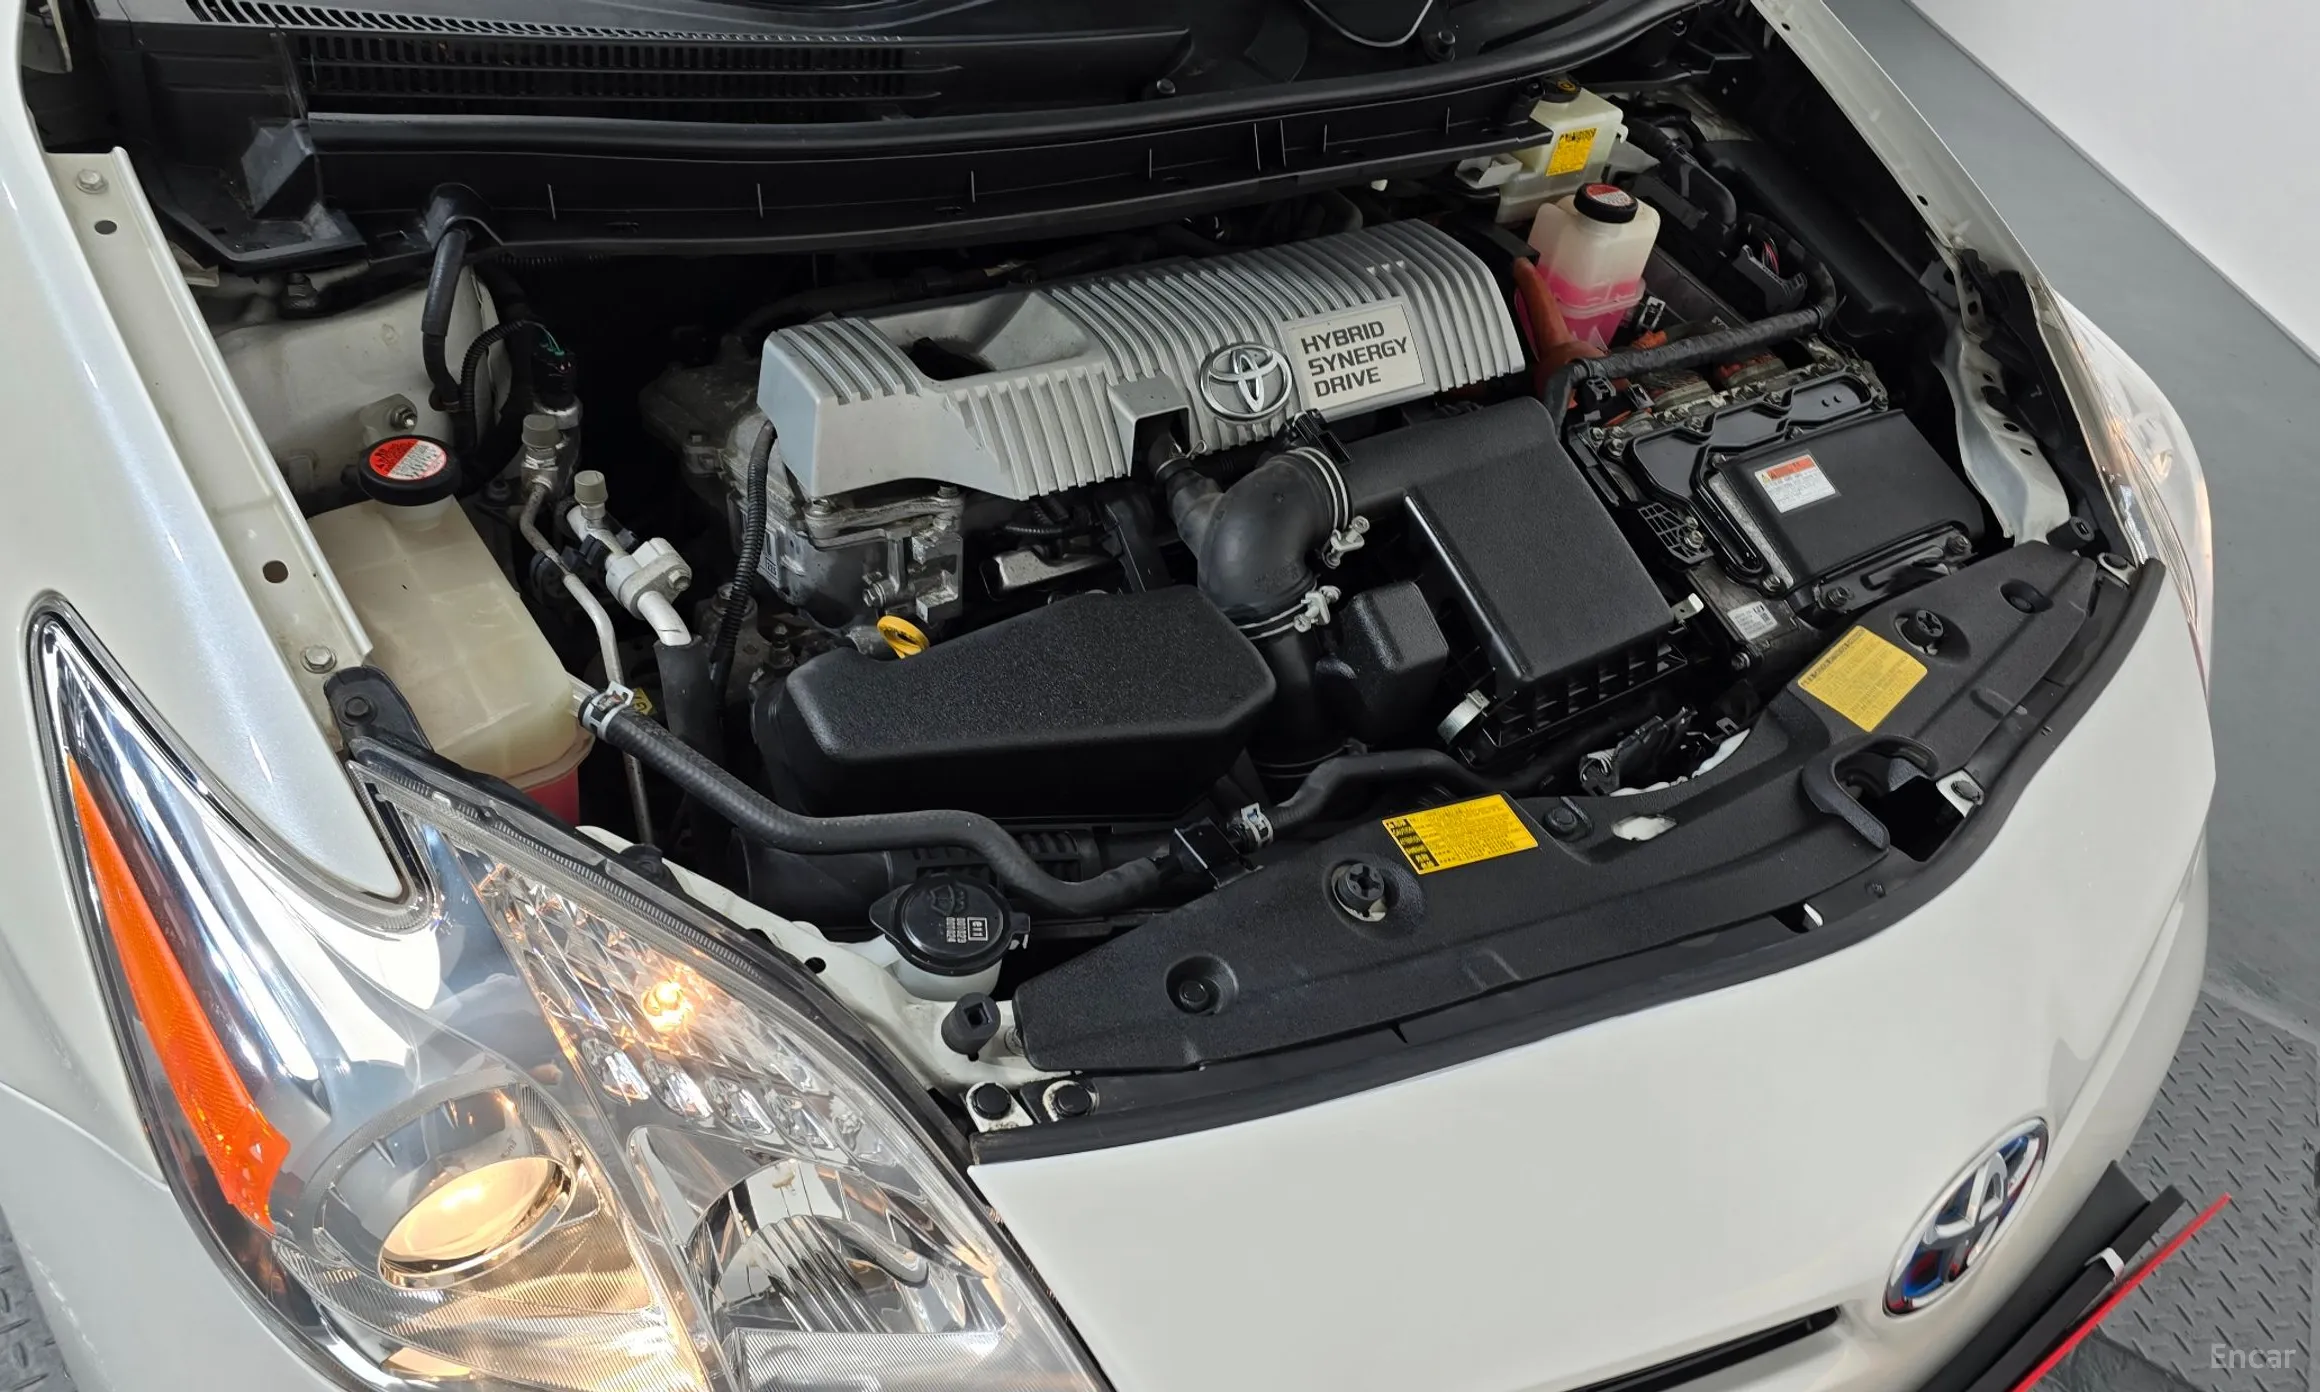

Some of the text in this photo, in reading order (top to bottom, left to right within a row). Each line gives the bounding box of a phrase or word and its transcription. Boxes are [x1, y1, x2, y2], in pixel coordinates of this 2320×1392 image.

[1301, 321, 1384, 354] HYBRID
[1308, 336, 1407, 377] SYNERGY
[1314, 366, 1381, 397] DRIVE
